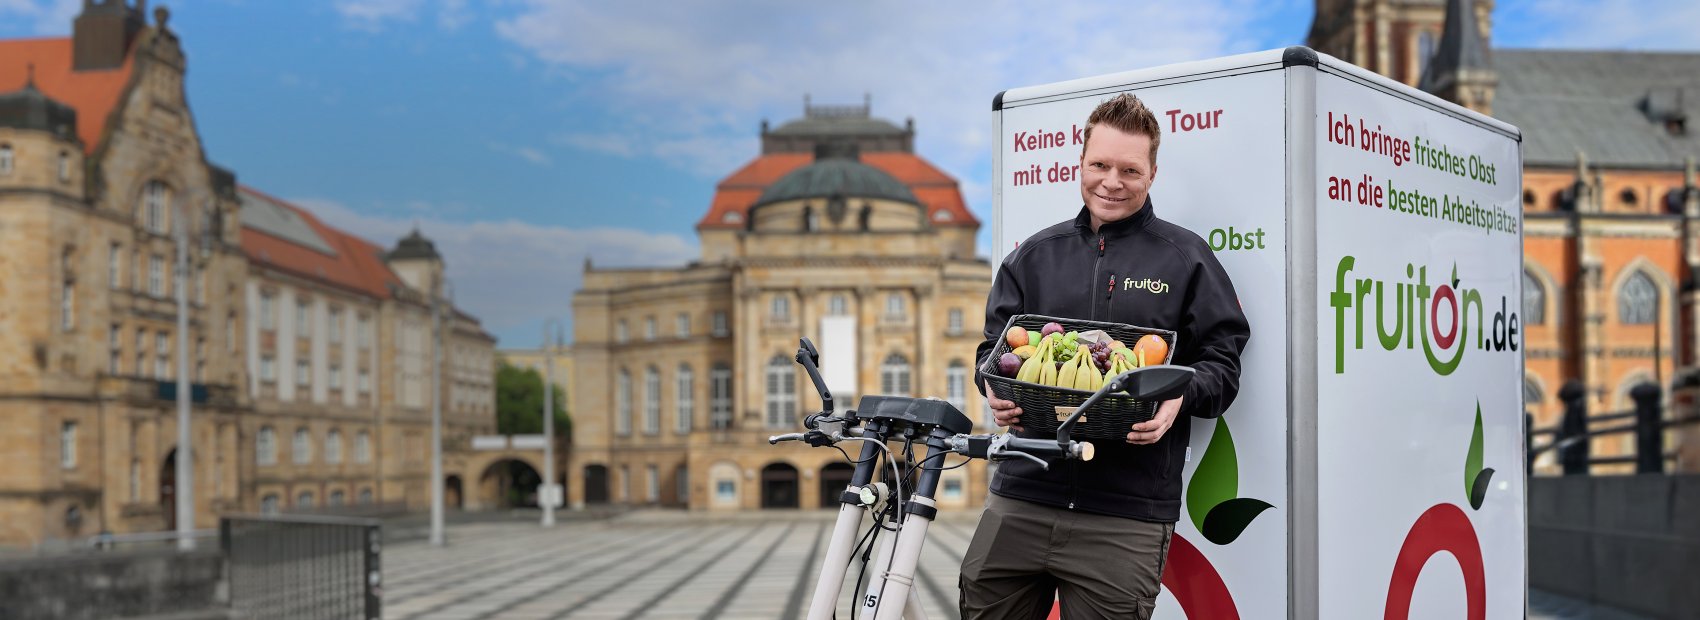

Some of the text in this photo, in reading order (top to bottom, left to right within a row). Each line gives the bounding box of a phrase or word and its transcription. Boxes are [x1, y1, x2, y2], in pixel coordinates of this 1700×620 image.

[1014, 129, 1066, 152] Keine
[1166, 109, 1223, 134] Tour
[1328, 111, 1496, 186] Ich bringe frisches Obst
[1014, 162, 1080, 186] mit der
[1328, 173, 1517, 235] an die besten Arbeitsplätze
[1208, 226, 1266, 252] Obst
[1124, 277, 1169, 294] fruiton
